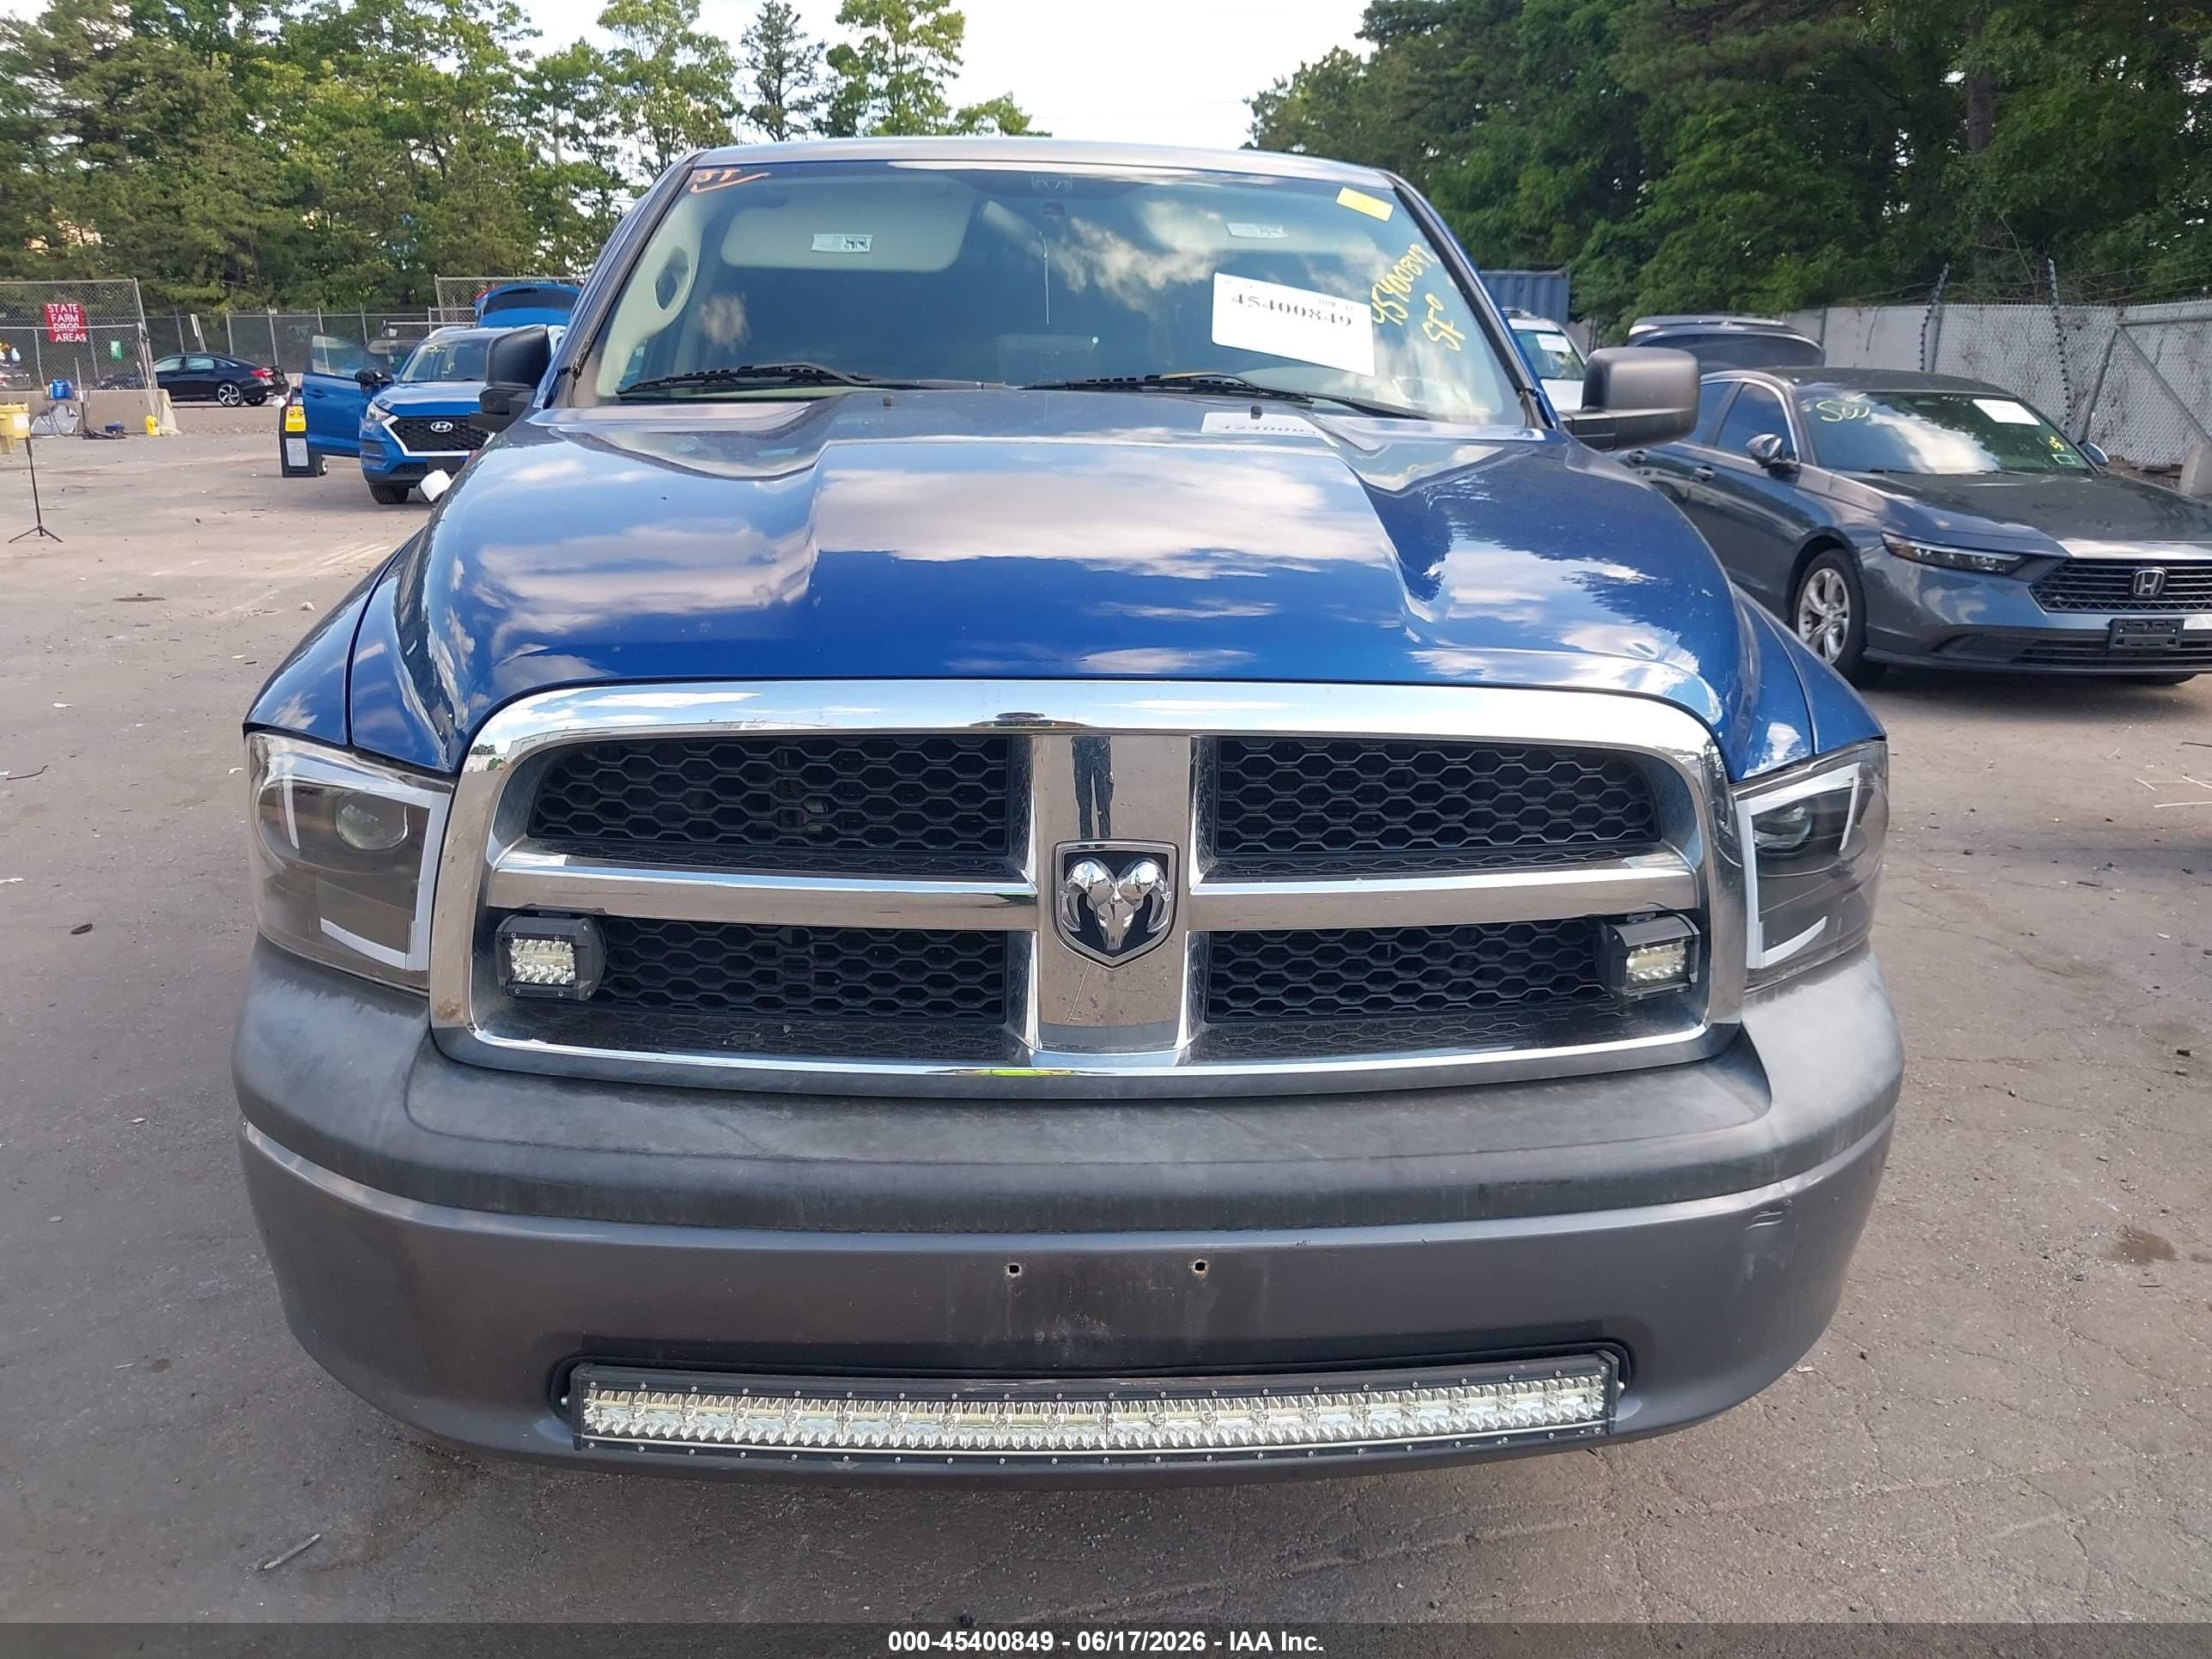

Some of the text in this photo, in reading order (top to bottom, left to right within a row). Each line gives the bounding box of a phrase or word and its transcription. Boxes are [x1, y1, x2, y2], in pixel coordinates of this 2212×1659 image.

[47, 303, 79, 313] STATE
[1231, 293, 1352, 326] 45400849
[53, 323, 80, 332] DROP
